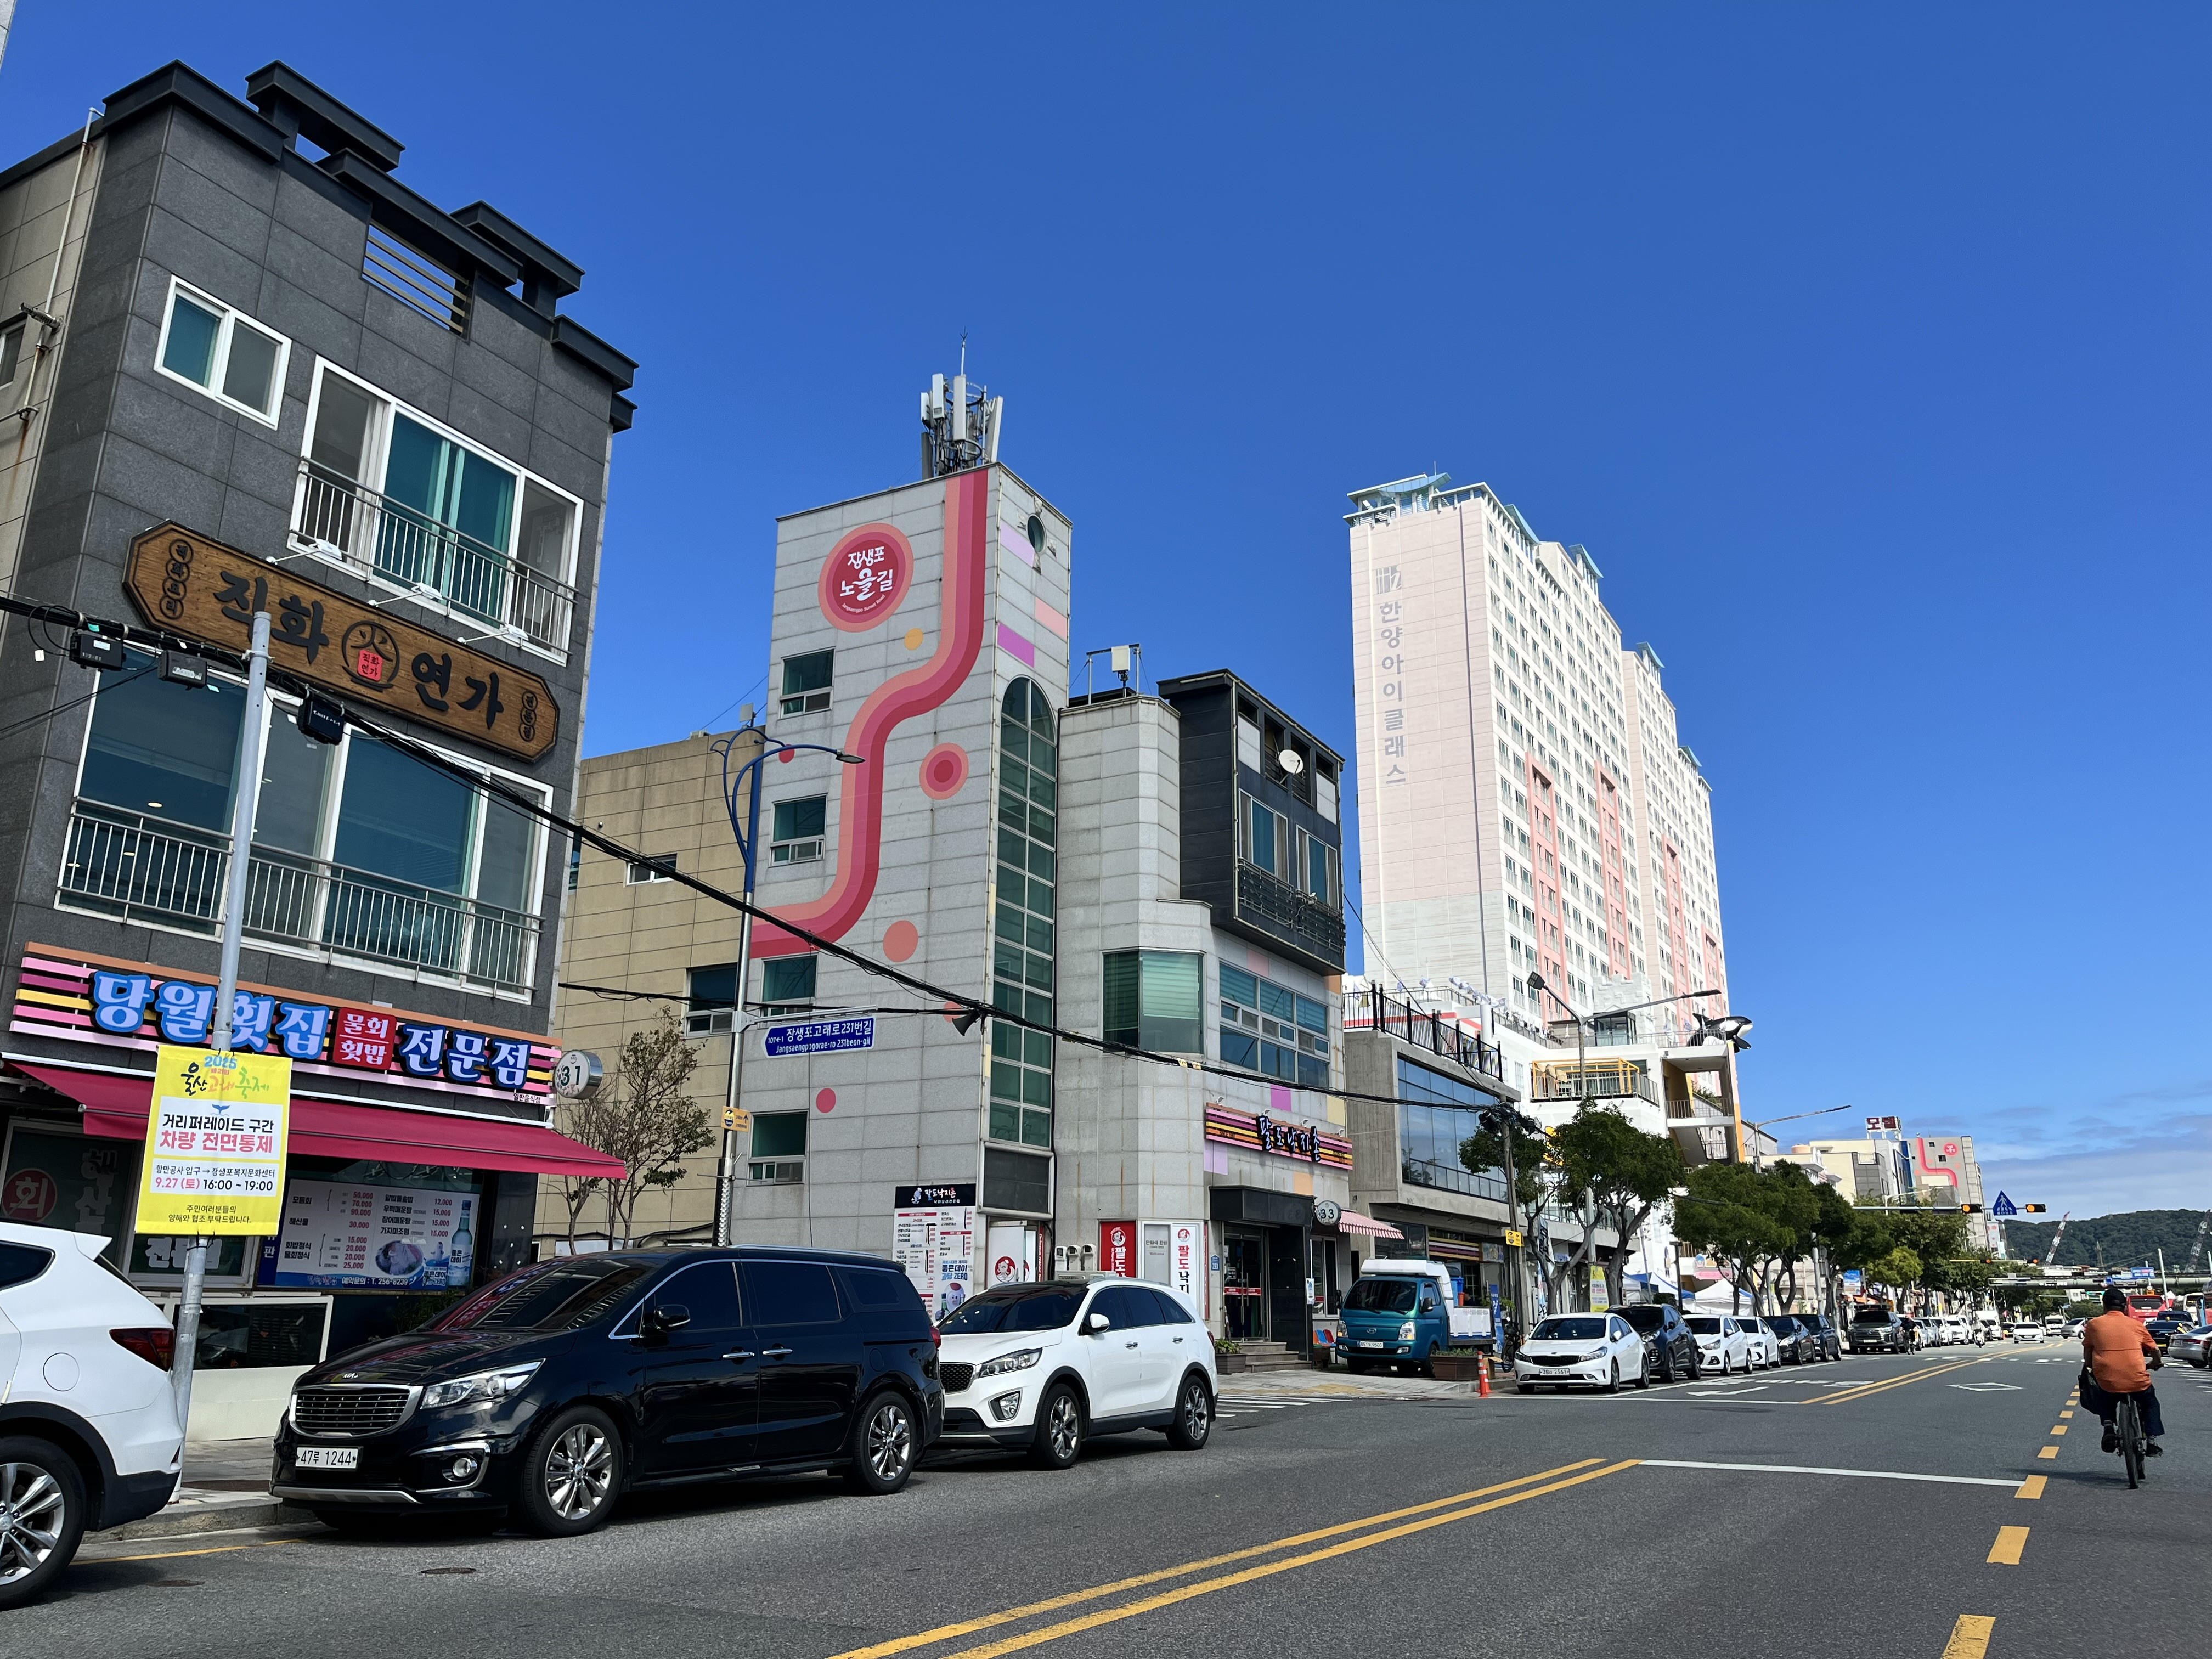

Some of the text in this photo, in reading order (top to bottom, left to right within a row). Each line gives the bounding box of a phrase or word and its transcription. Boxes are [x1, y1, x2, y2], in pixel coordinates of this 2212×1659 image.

[848, 546, 884, 569] 장생포
[840, 568, 893, 601] 노을길
[213, 571, 504, 730] 직화 火 연가
[362, 653, 380, 667] 직화
[360, 664, 378, 678] 연가
[1380, 602, 1406, 785] 한양아이클래스
[95, 972, 530, 1089] 당월횟집 전문점
[343, 1013, 388, 1038] 물회
[786, 1020, 871, 1042] 장생포고래로231번길
[837, 1036, 871, 1048] 231beon-gil
[340, 1042, 387, 1065] 횟밥
[204, 1056, 238, 1069] 2025
[561, 1066, 580, 1086] 31
[514, 1093, 540, 1104] 일반음식점
[249, 1119, 274, 1133] 구간
[160, 1130, 273, 1153] 차량 전면통제
[1257, 1116, 1320, 1161] 팔도낙지촌
[156, 1165, 275, 1178] 항만공사 입구 장생포복지문화센터
[155, 1177, 178, 1188] 9.27
[181, 1178, 200, 1189] (토)
[204, 1179, 232, 1190] 16:00
[245, 1180, 273, 1191] 19:00
[10, 1176, 48, 1218] 회
[924, 1187, 956, 1201] 팔도낙지촌
[187, 1205, 236, 1214] 주민여러분들의
[1320, 1209, 1334, 1219] 33
[168, 1214, 189, 1223] 양해와
[192, 1215, 206, 1223] 협조
[954, 1272, 968, 1280] ZERO
[325, 1448, 351, 1466] 1244
